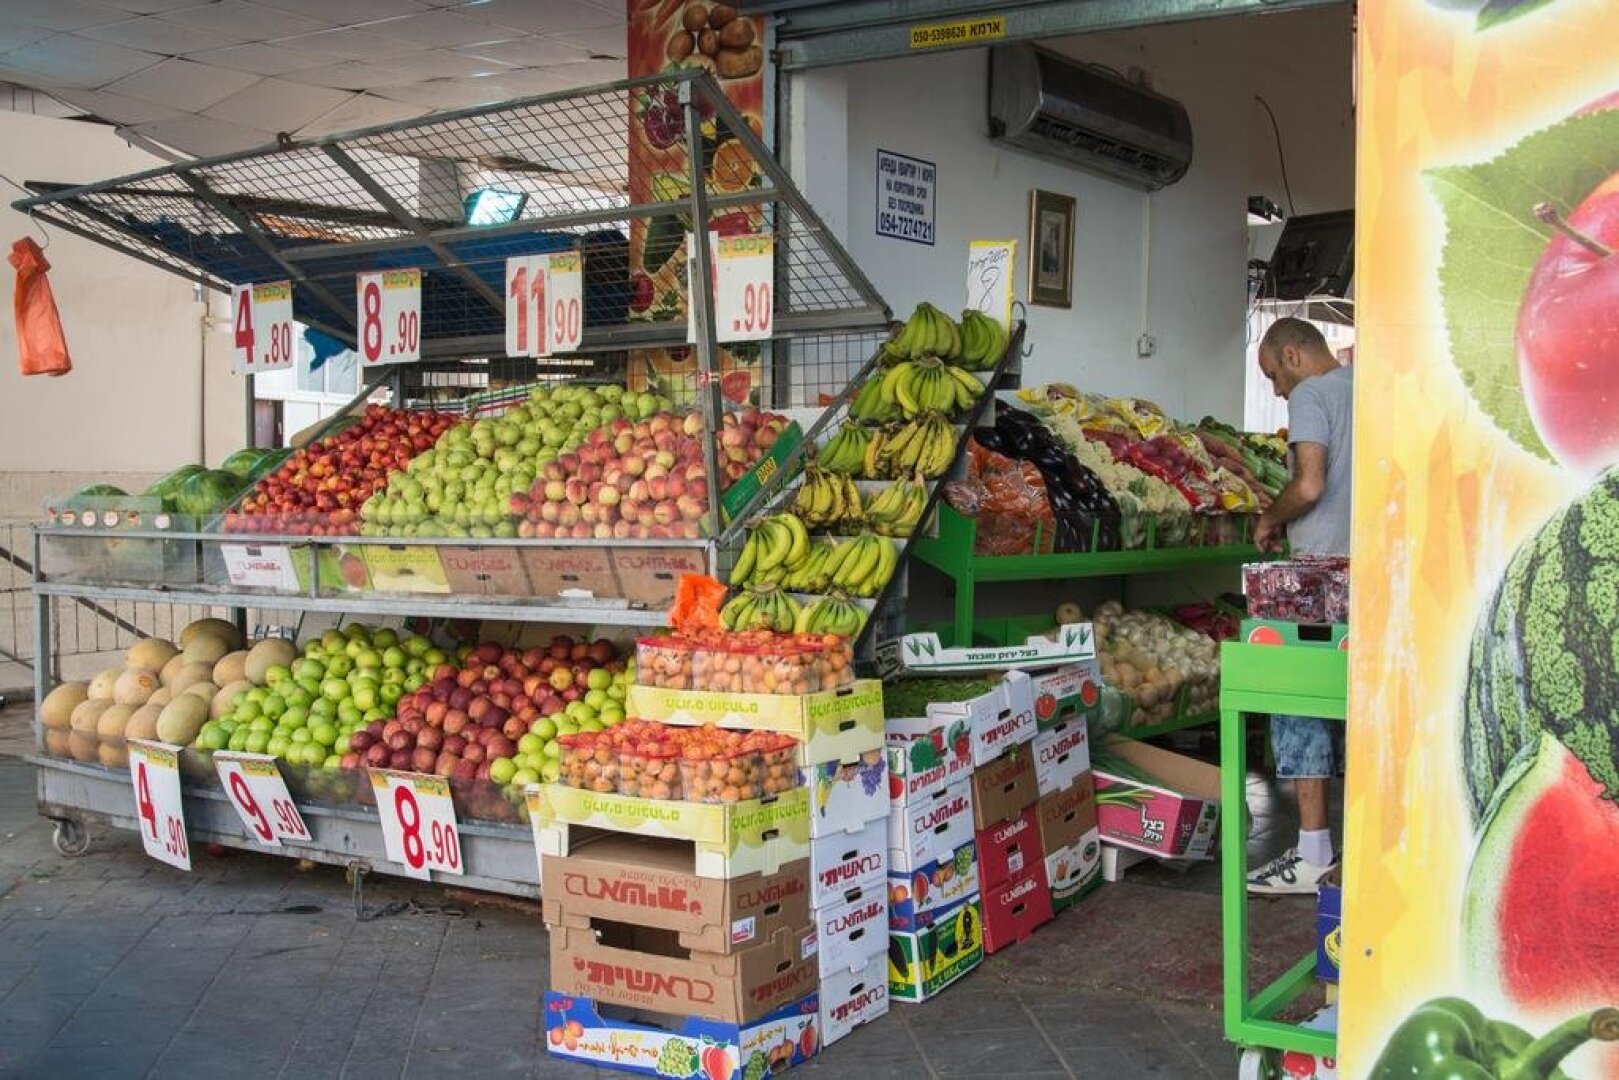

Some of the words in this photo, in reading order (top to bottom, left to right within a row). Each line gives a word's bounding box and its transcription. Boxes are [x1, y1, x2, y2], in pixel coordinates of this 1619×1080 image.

[229, 771, 306, 841] 9.90
[394, 785, 459, 869] 8.90
[1141, 803, 1165, 832] בצל
